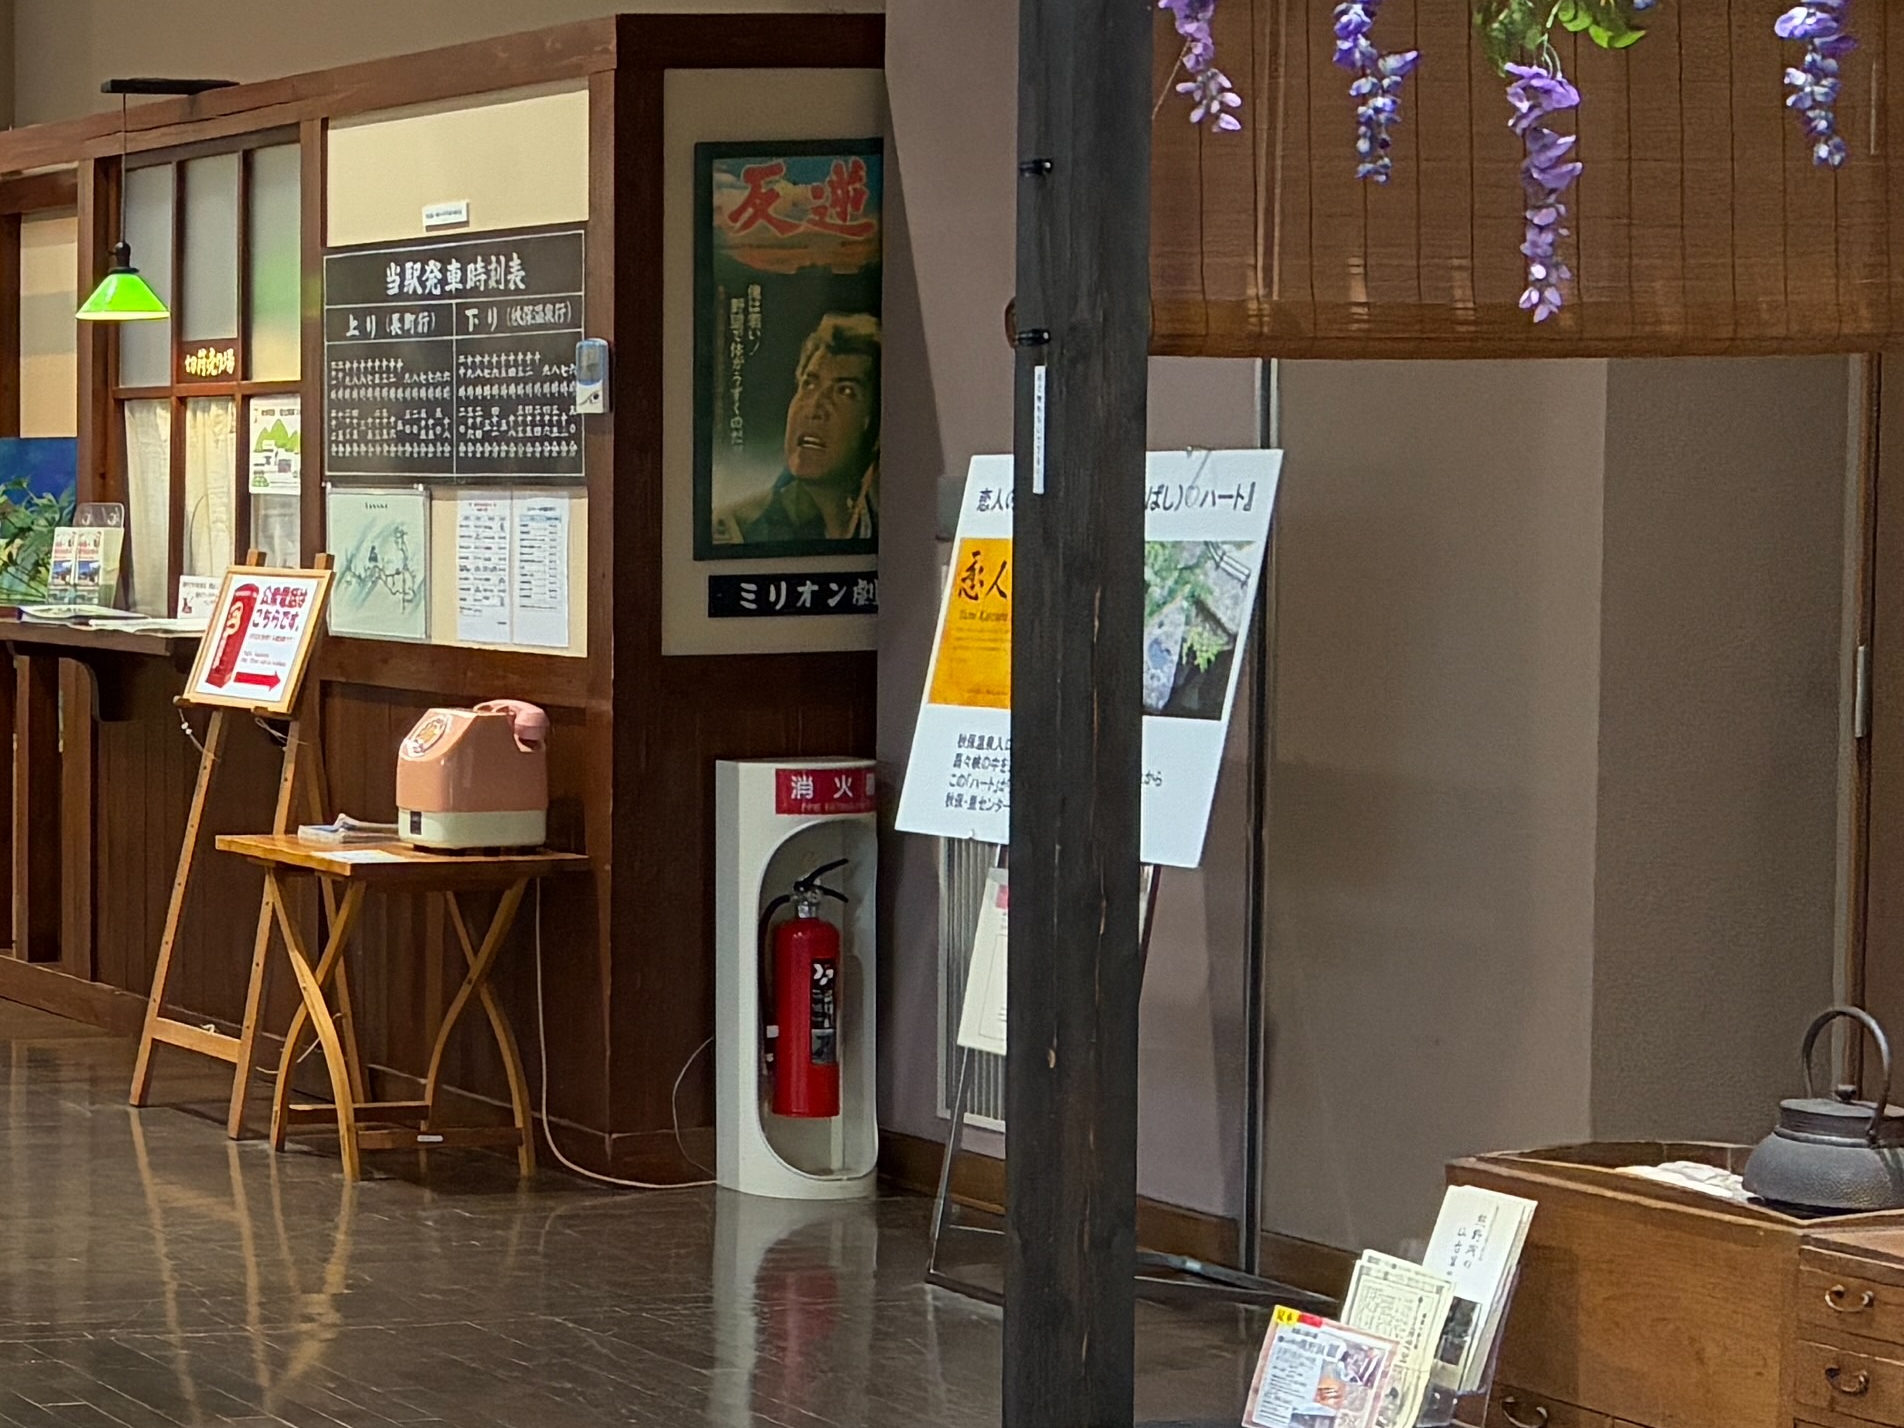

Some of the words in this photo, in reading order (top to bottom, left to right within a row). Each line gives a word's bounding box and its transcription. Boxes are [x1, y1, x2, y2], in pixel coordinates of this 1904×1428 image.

[384, 252, 527, 297] 当駅発車時刻表
[739, 577, 879, 611] ミリオン劇
[957, 550, 1008, 603] 恋人
